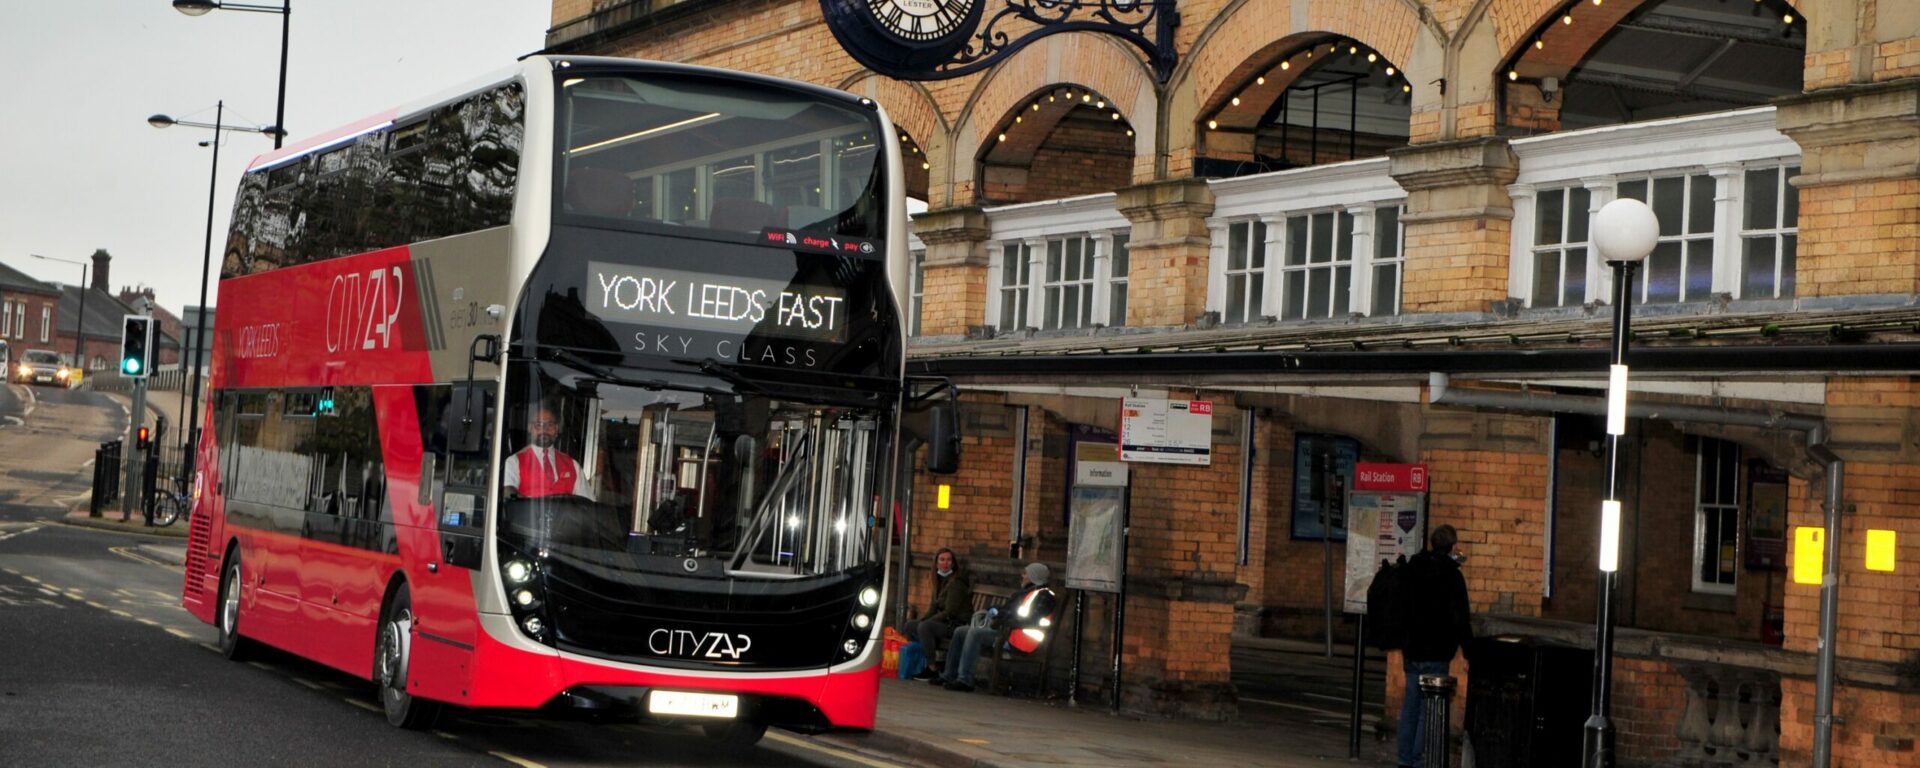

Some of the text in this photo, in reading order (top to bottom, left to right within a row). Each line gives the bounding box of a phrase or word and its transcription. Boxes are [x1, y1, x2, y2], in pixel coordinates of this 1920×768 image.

[902, 1, 932, 9] LESTER
[767, 232, 859, 252] WiFi charge pay
[326, 266, 403, 353] CITYZAP
[598, 272, 844, 331] YORK LEEDS FAST
[634, 331, 817, 368] SKY CLASS
[1360, 471, 1395, 483] Rail Station
[648, 628, 752, 659] CITYZAP
